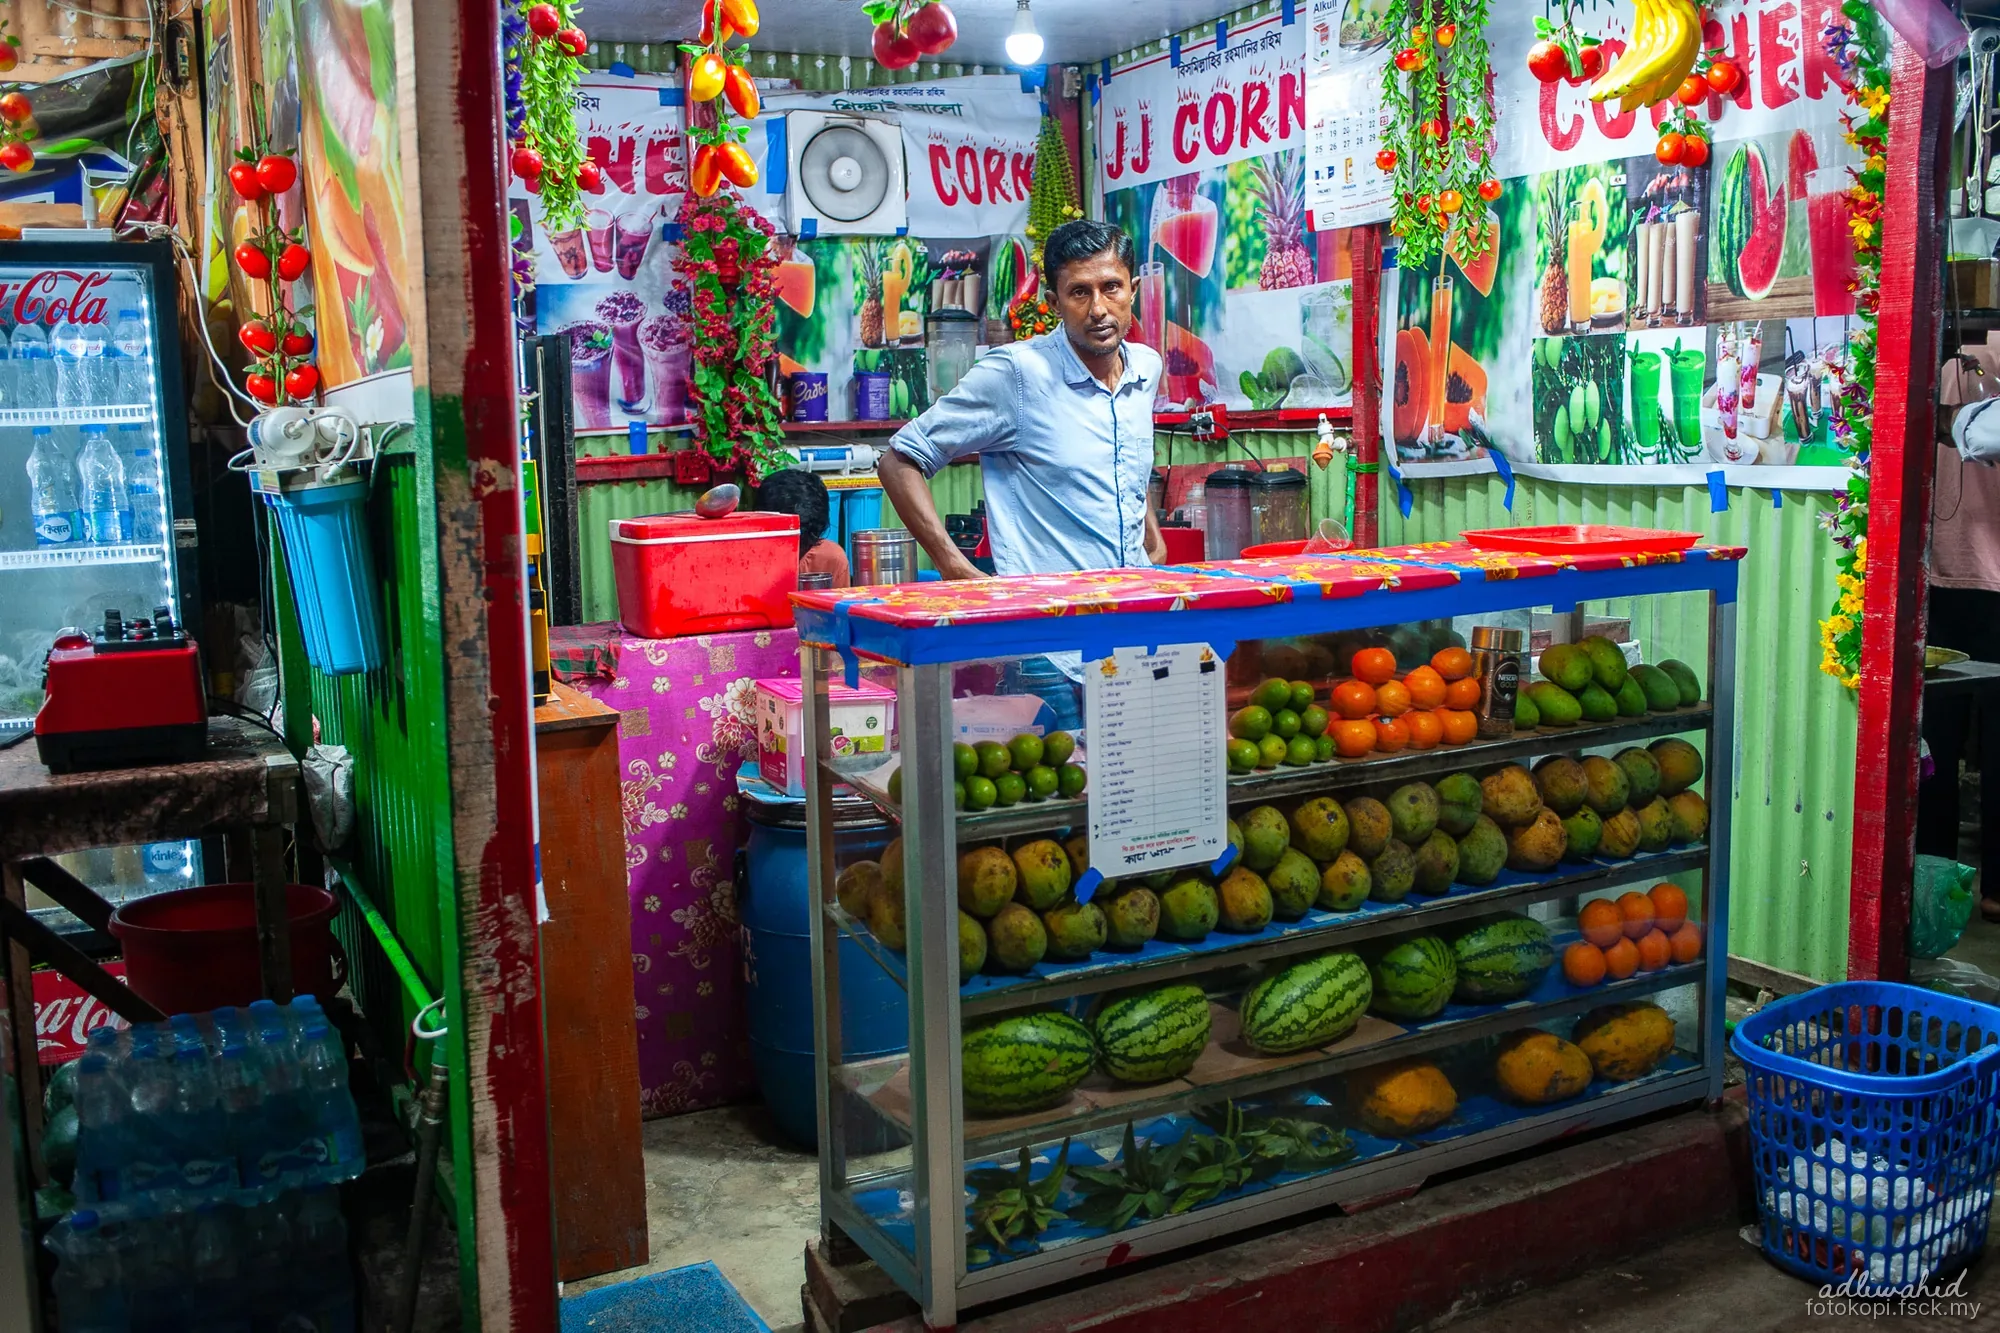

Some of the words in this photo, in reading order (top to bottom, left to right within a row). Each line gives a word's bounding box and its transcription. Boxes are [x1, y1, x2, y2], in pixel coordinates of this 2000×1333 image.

[1260, 30, 1282, 51] রহিম
[1106, 112, 1152, 180] JJ
[1172, 67, 1305, 165] CORN
